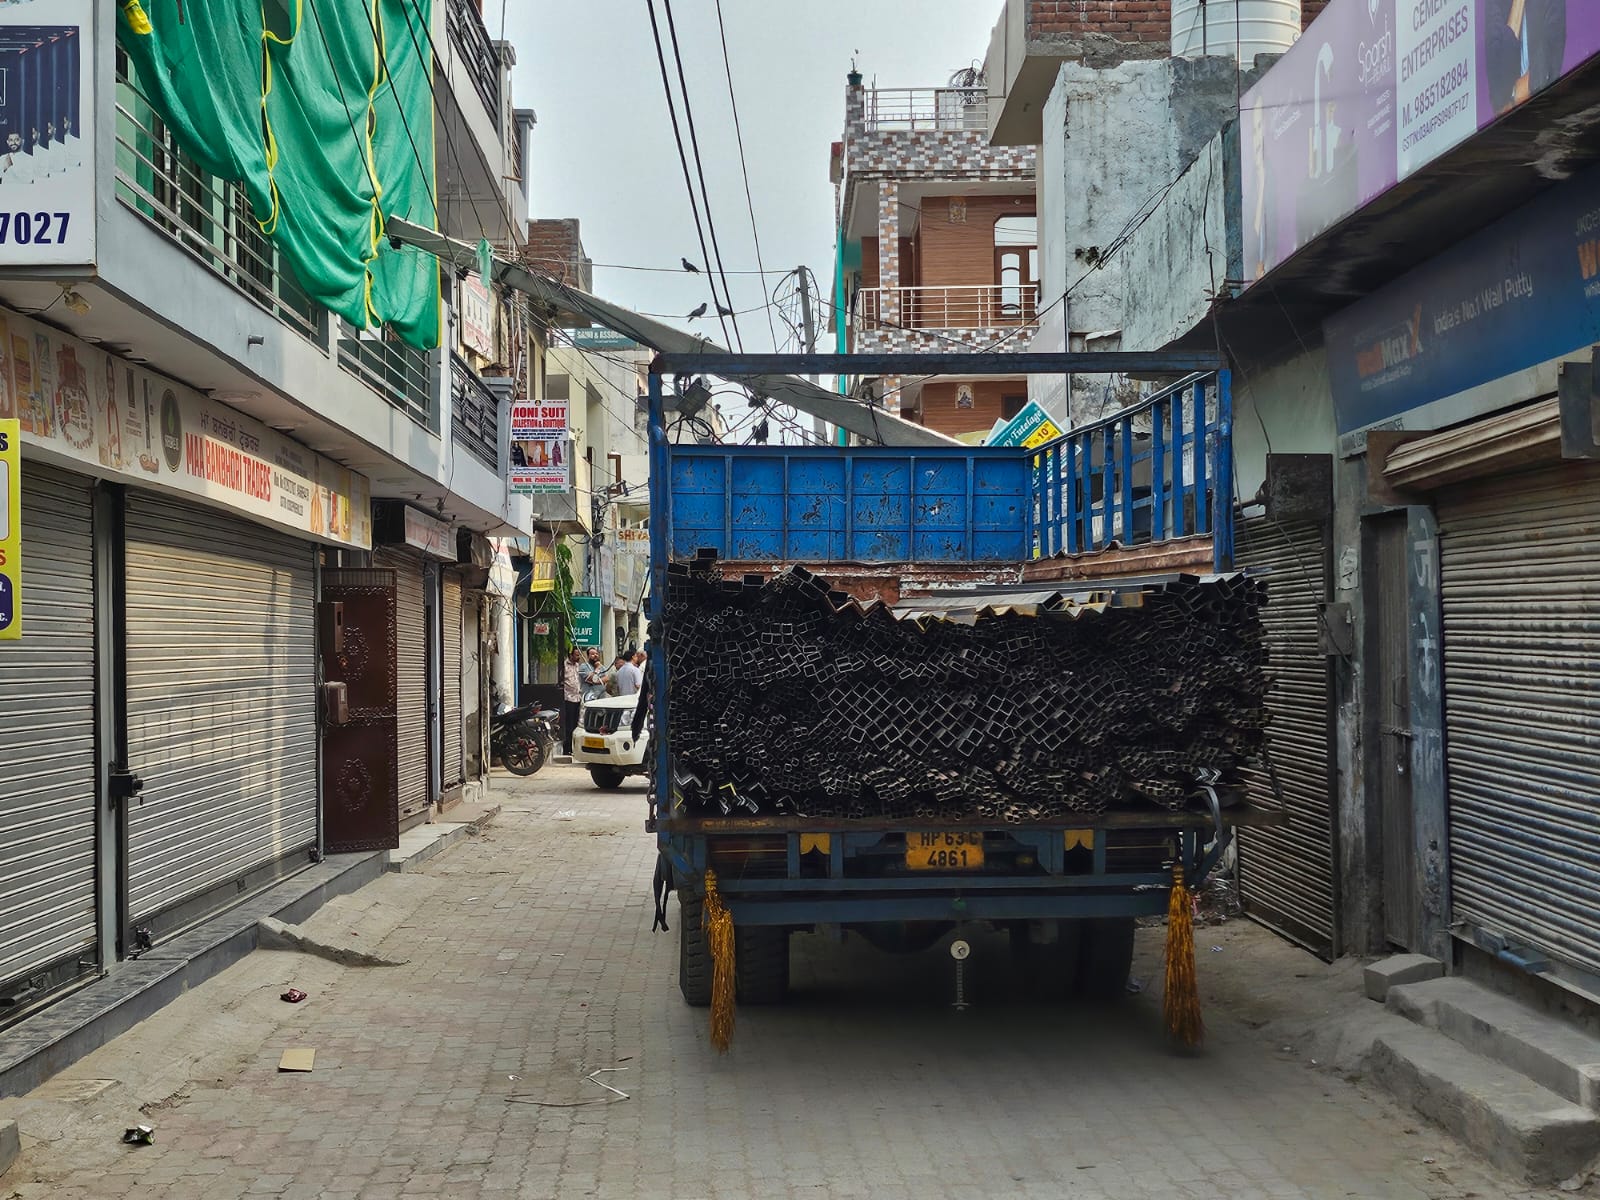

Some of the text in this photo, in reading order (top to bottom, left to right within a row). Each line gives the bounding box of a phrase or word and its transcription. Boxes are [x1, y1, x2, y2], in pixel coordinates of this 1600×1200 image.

[1401, 5, 1468, 82] ENTERPRISES
[1402, 103, 1413, 128] M.
[1413, 58, 1468, 119] 9855182884
[1461, 299, 1482, 321] No.1
[1481, 285, 1503, 313] Wall
[1504, 271, 1533, 298] Putty
[541, 407, 566, 418] SUIT
[1010, 410, 1042, 440] Tutelage
[185, 432, 205, 479] MAA
[205, 439, 243, 492] BANBHORI
[243, 455, 271, 502] TRADERS
[927, 849, 967, 867] 4861
